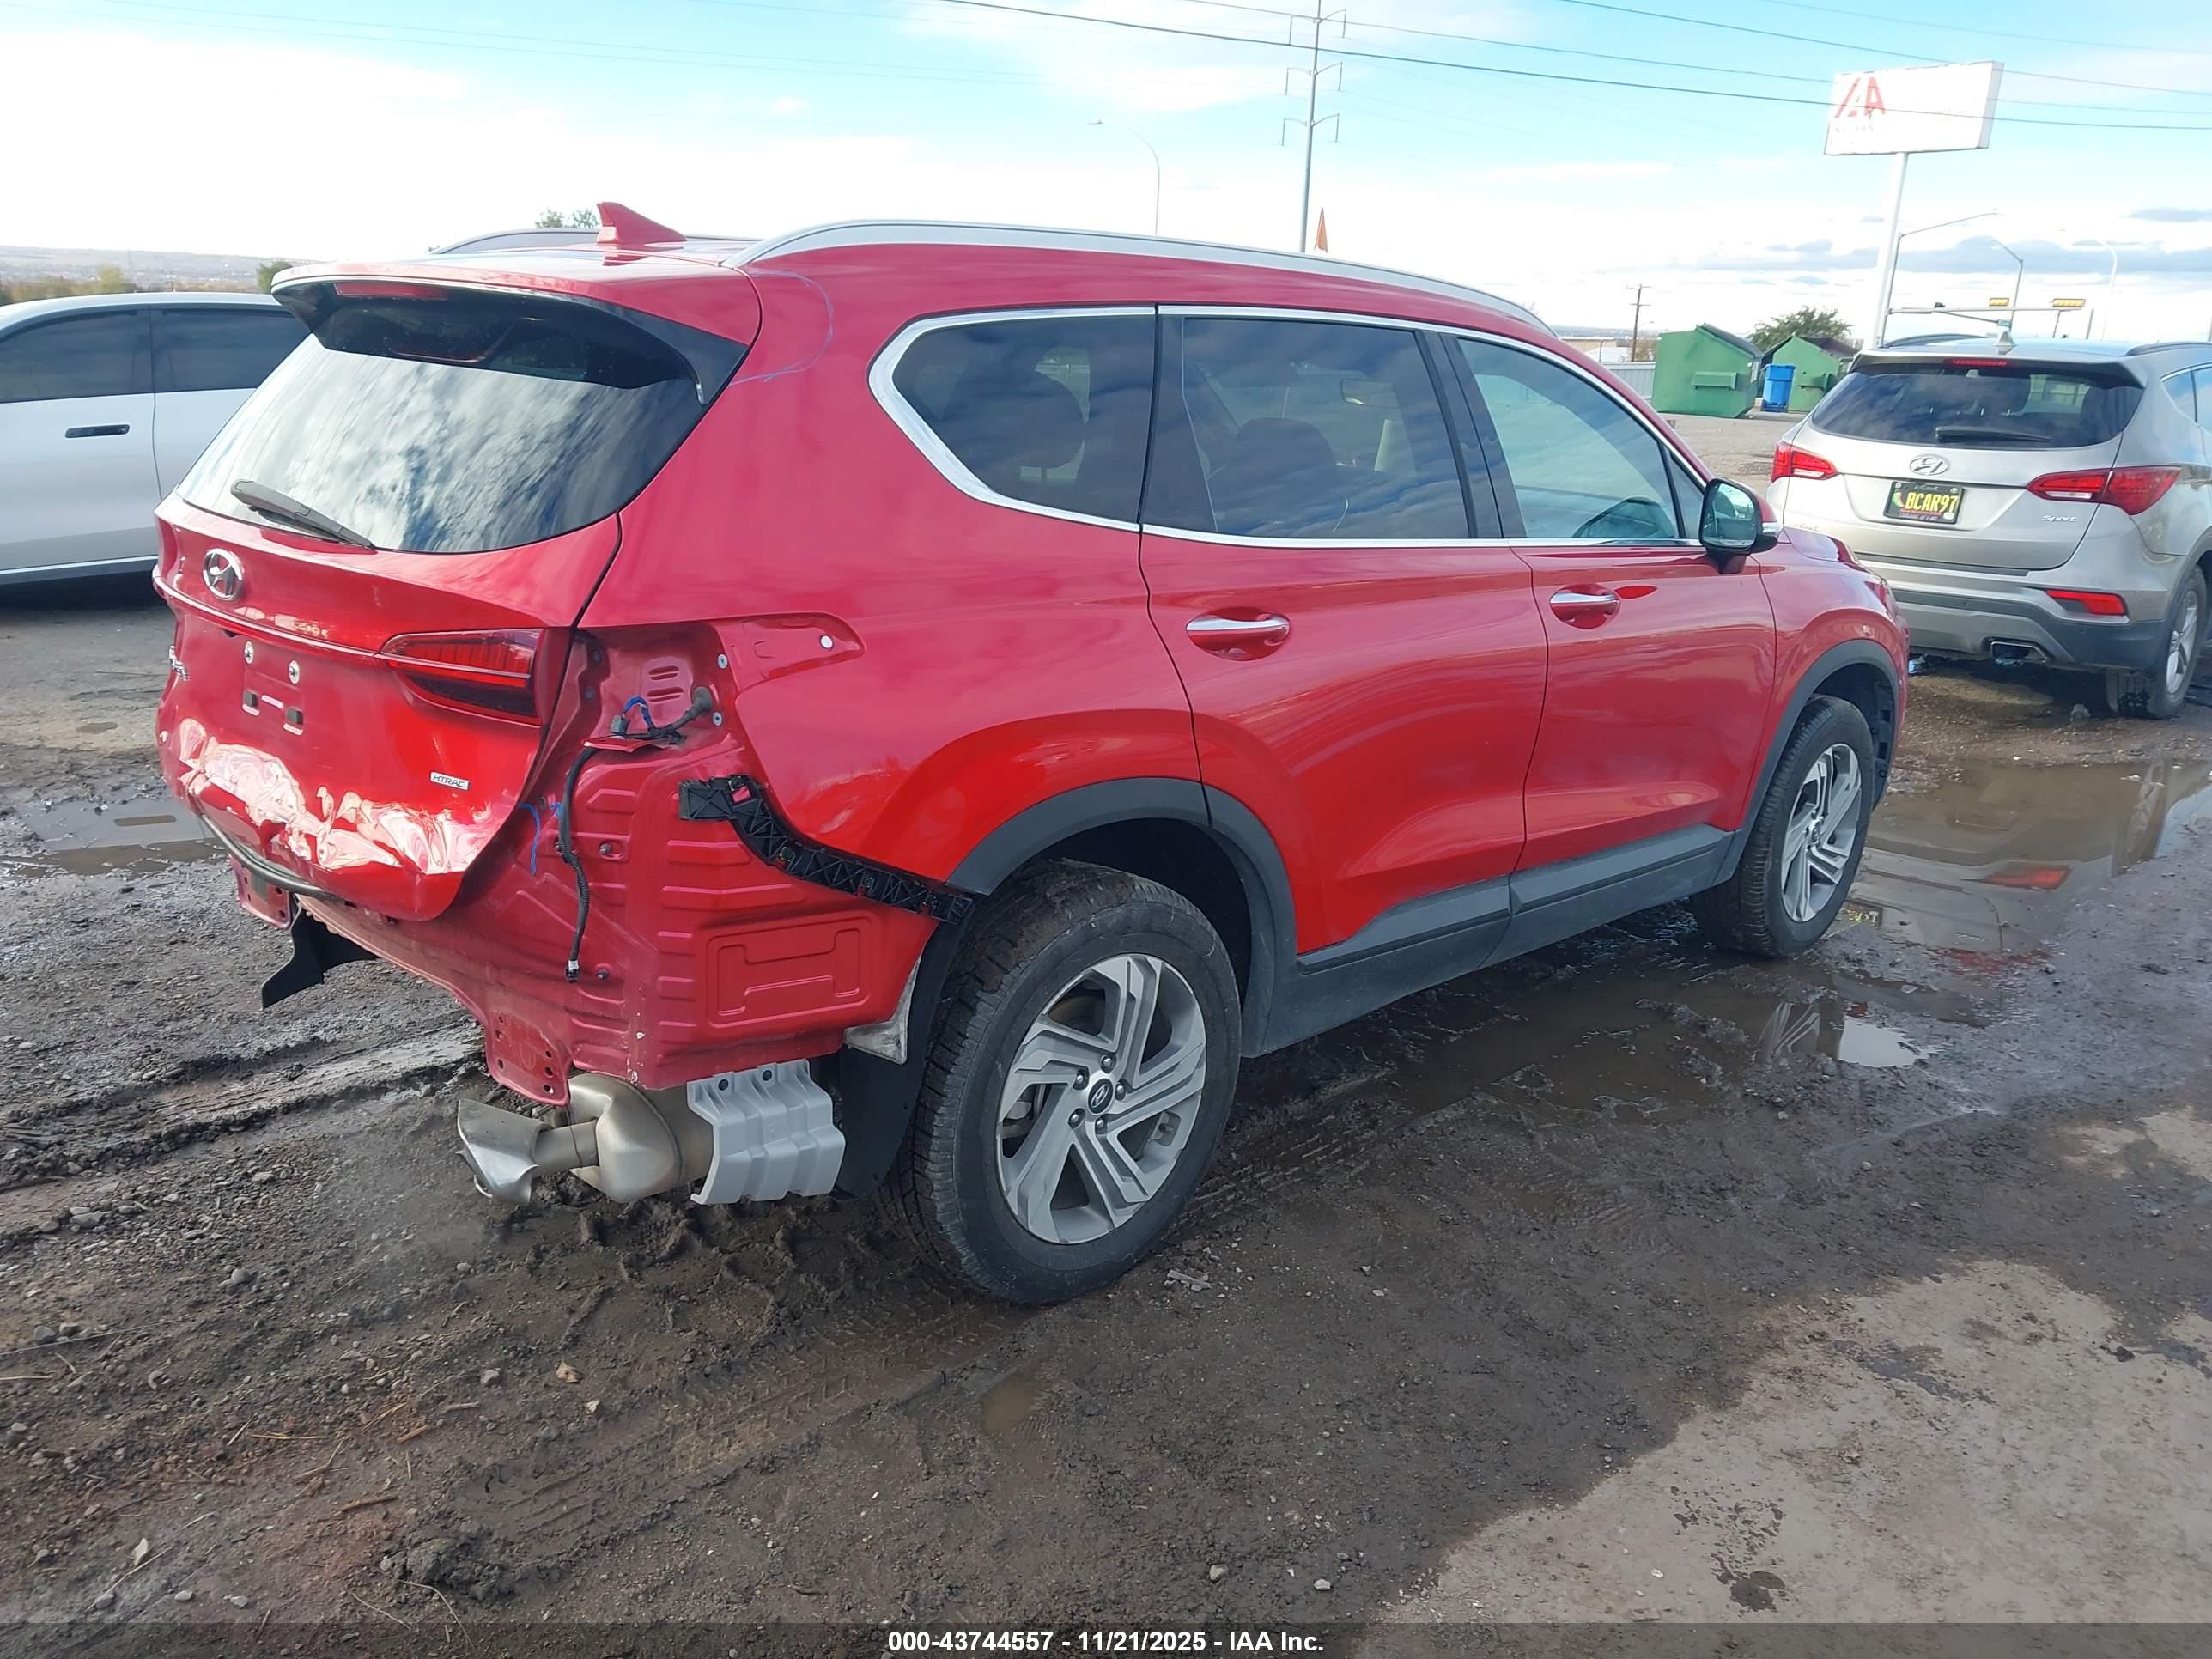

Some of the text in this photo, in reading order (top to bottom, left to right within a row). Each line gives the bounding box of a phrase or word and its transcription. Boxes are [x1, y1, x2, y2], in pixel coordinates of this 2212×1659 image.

[1904, 492, 1959, 514] BCAR97
[2041, 514, 2078, 523] Sport
[432, 774, 467, 788] HTRAC
